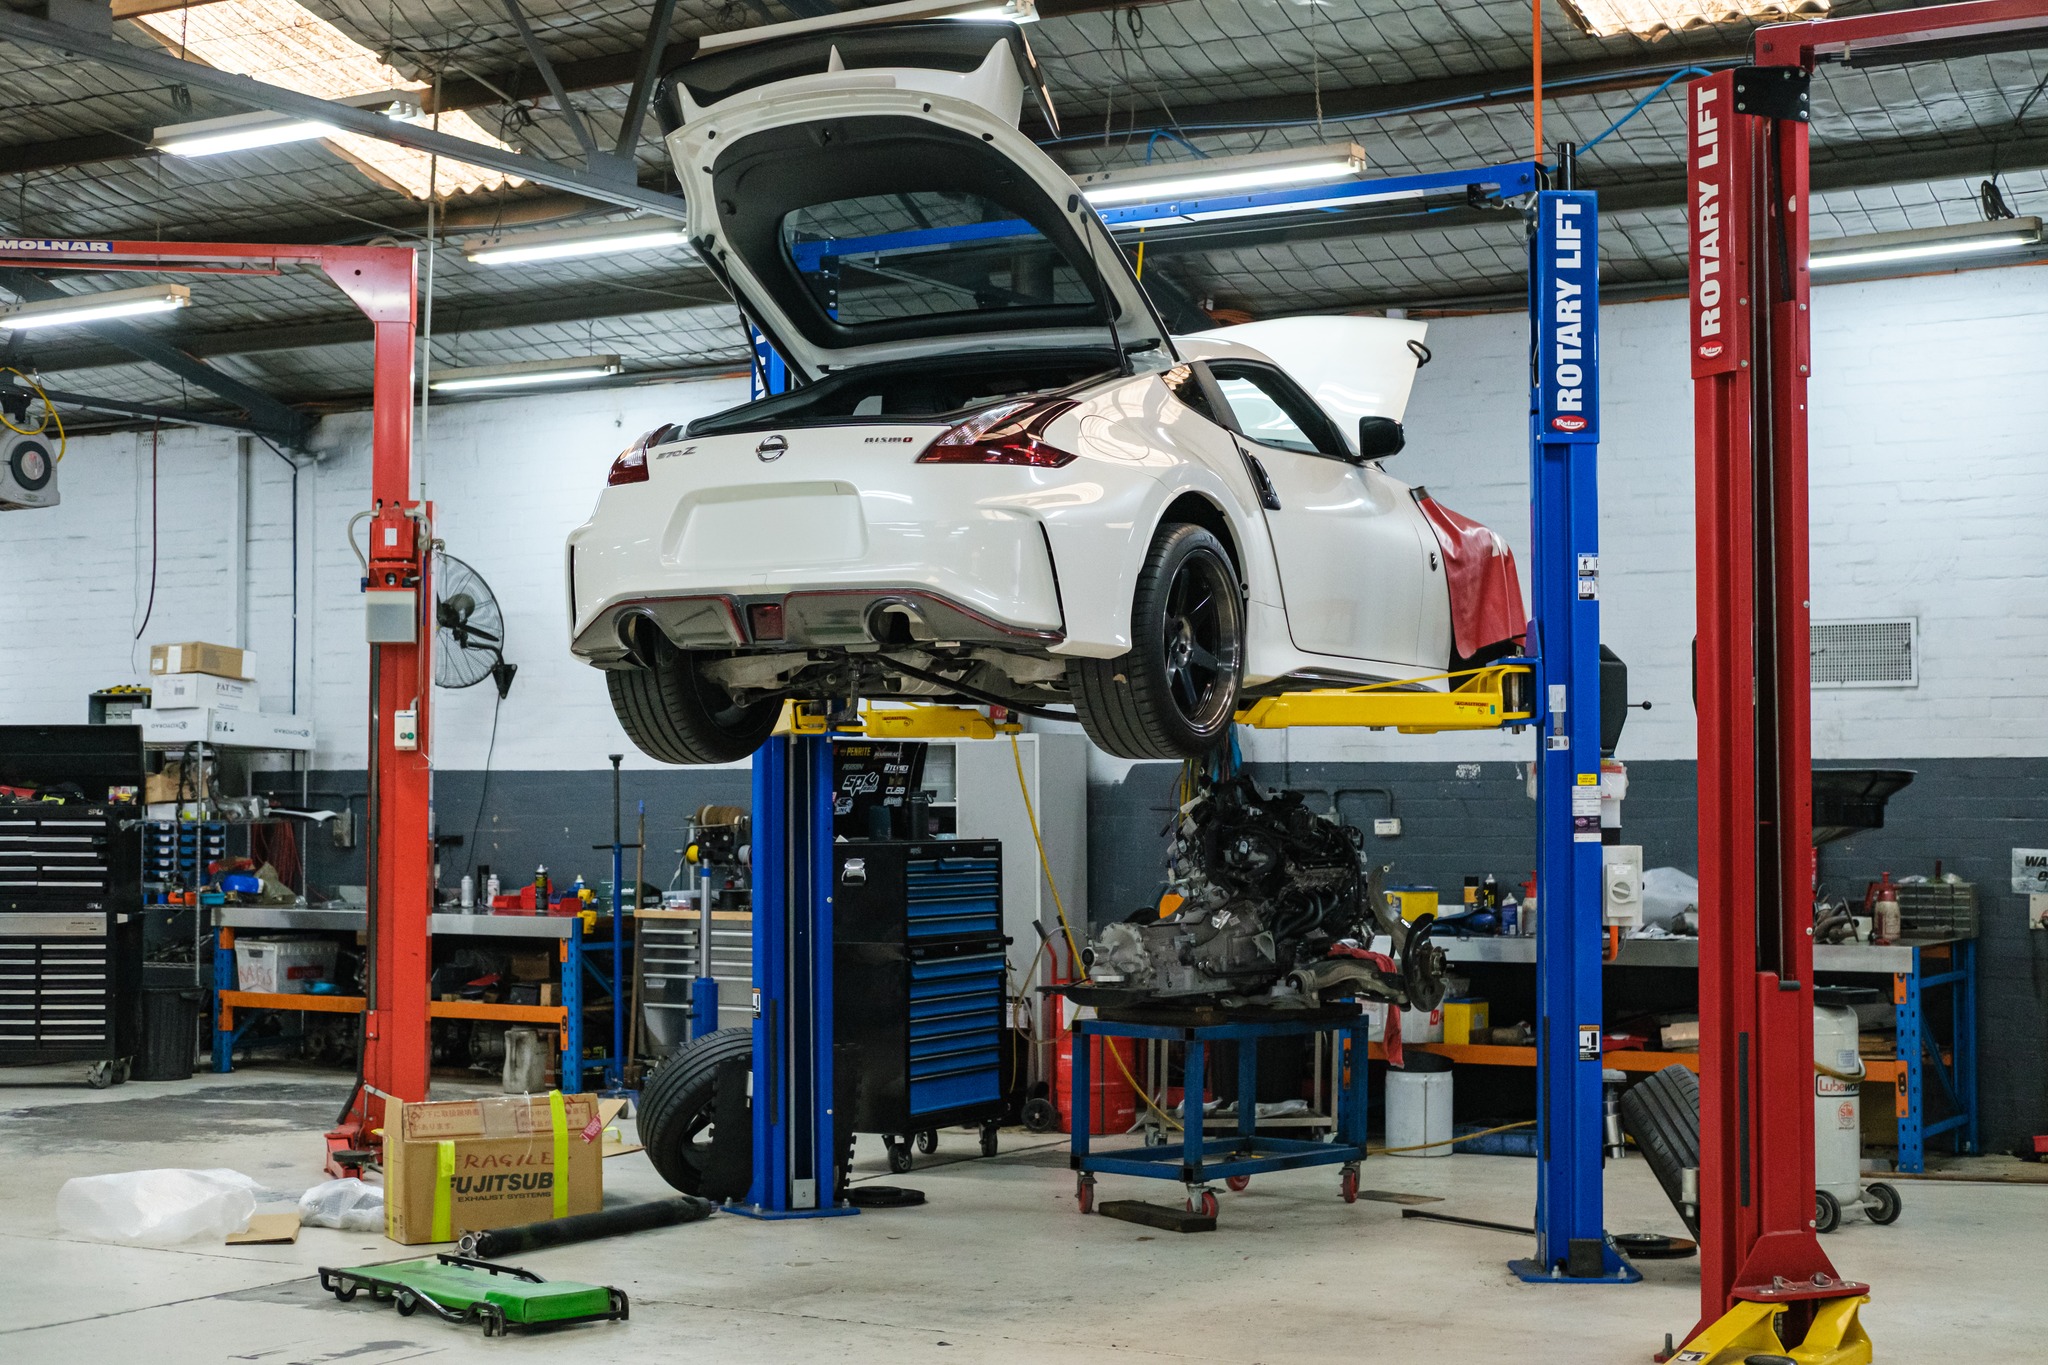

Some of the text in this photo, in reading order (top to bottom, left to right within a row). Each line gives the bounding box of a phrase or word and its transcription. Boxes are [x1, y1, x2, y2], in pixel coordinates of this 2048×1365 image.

[1698, 86, 1721, 338] ROTARY LIFT
[0, 240, 110, 252] MOLNAR
[1556, 199, 1582, 411] ROTARY LIFT
[1556, 418, 1584, 429] Rotary
[455, 1152, 554, 1170] RAGILE
[451, 1172, 569, 1193] UJITSUB
[458, 1191, 552, 1203] EXHAUST SYSTEMS
